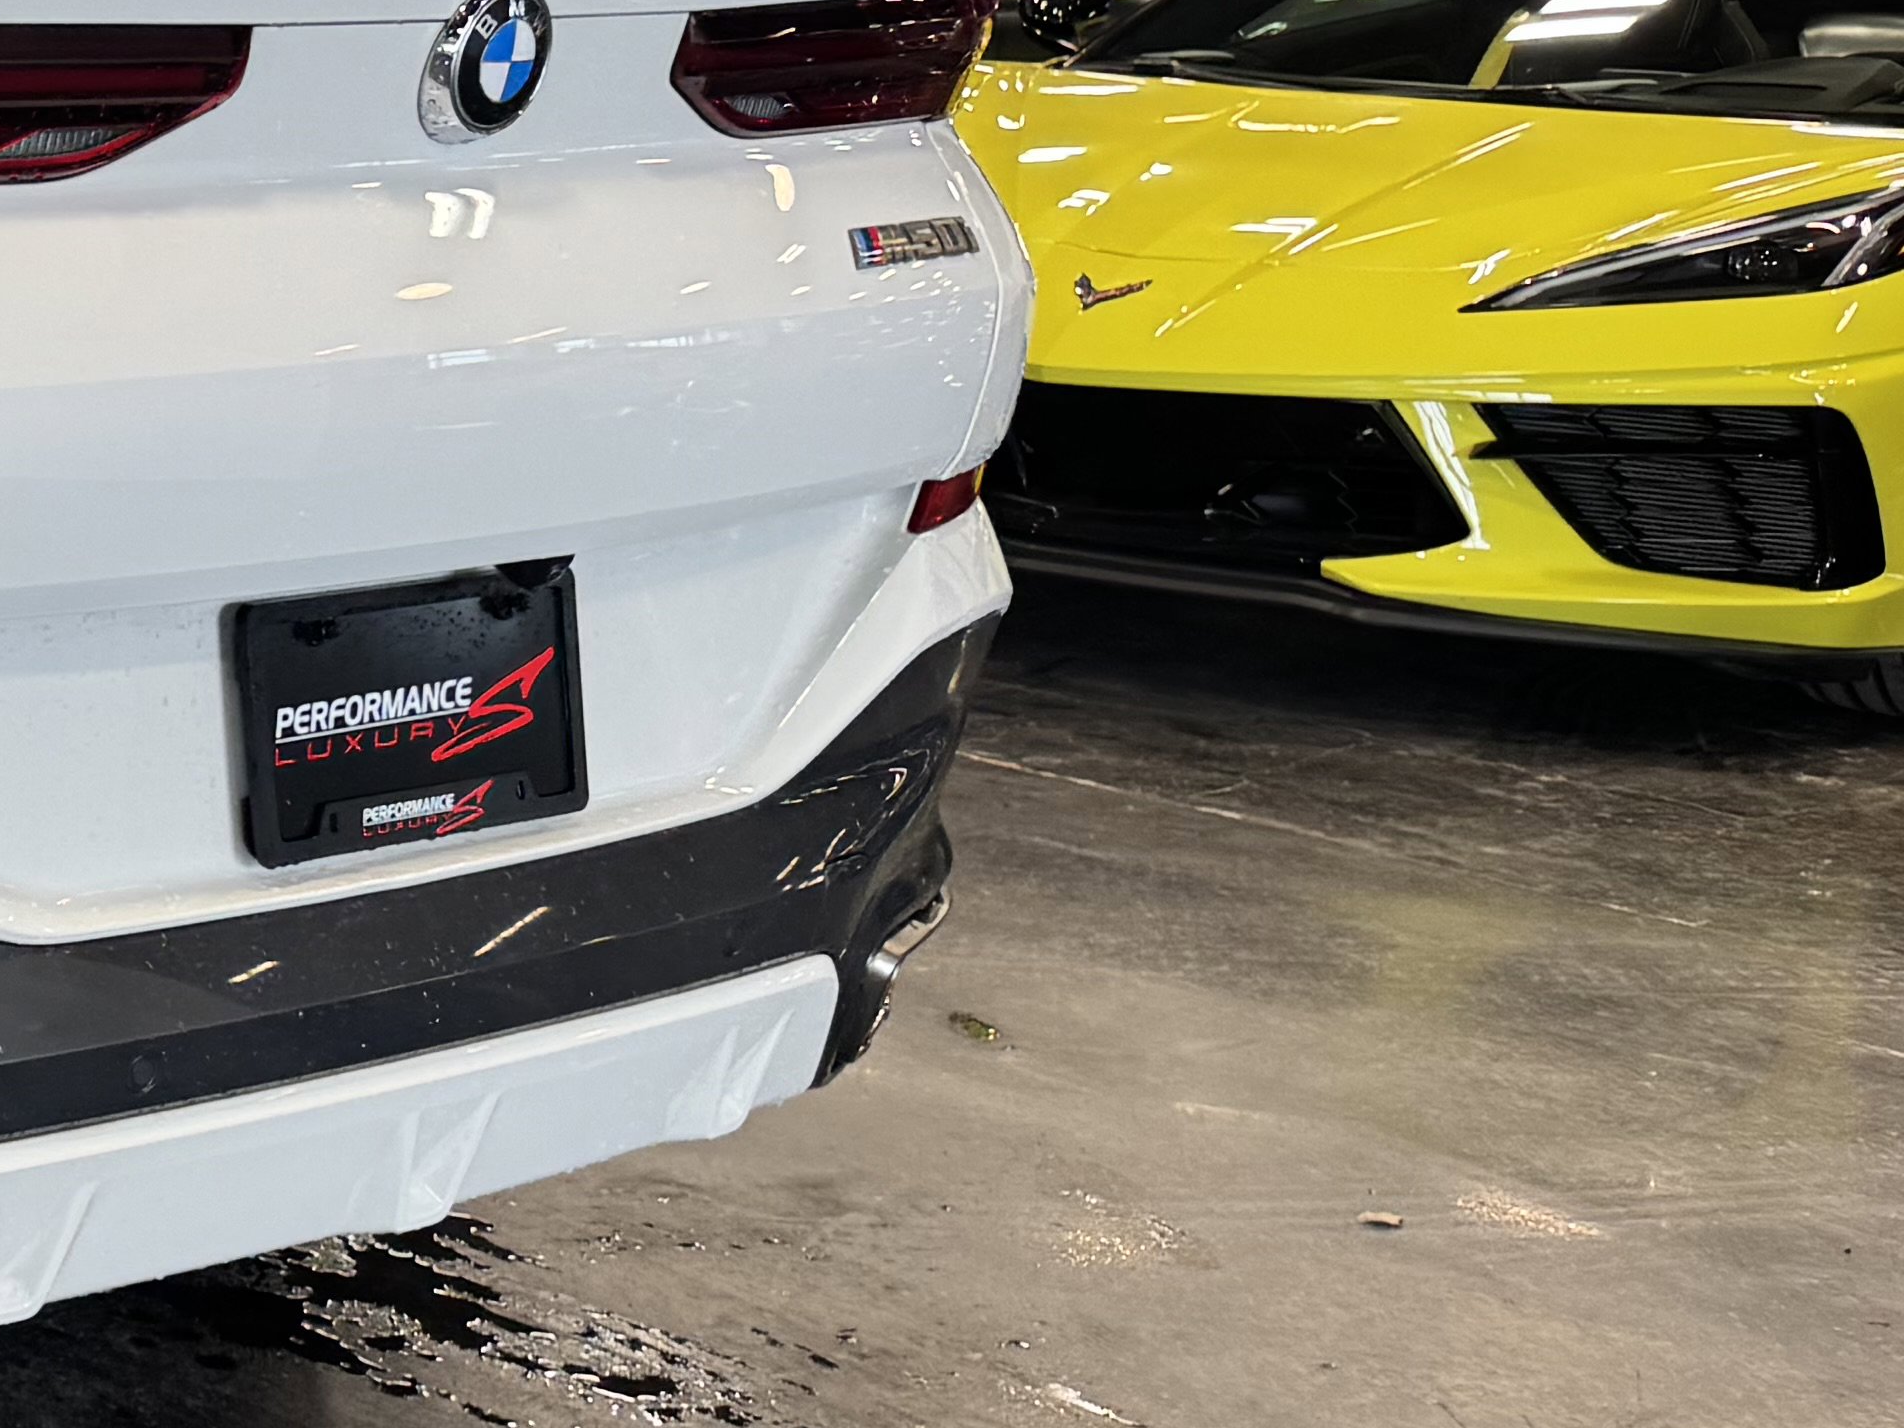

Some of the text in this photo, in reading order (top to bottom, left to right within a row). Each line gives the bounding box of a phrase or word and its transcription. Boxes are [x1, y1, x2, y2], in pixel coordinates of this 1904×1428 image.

[275, 676, 473, 739] PERFORMANCE
[275, 715, 468, 767] LUXURY
[362, 793, 456, 826] PERFORMANCE
